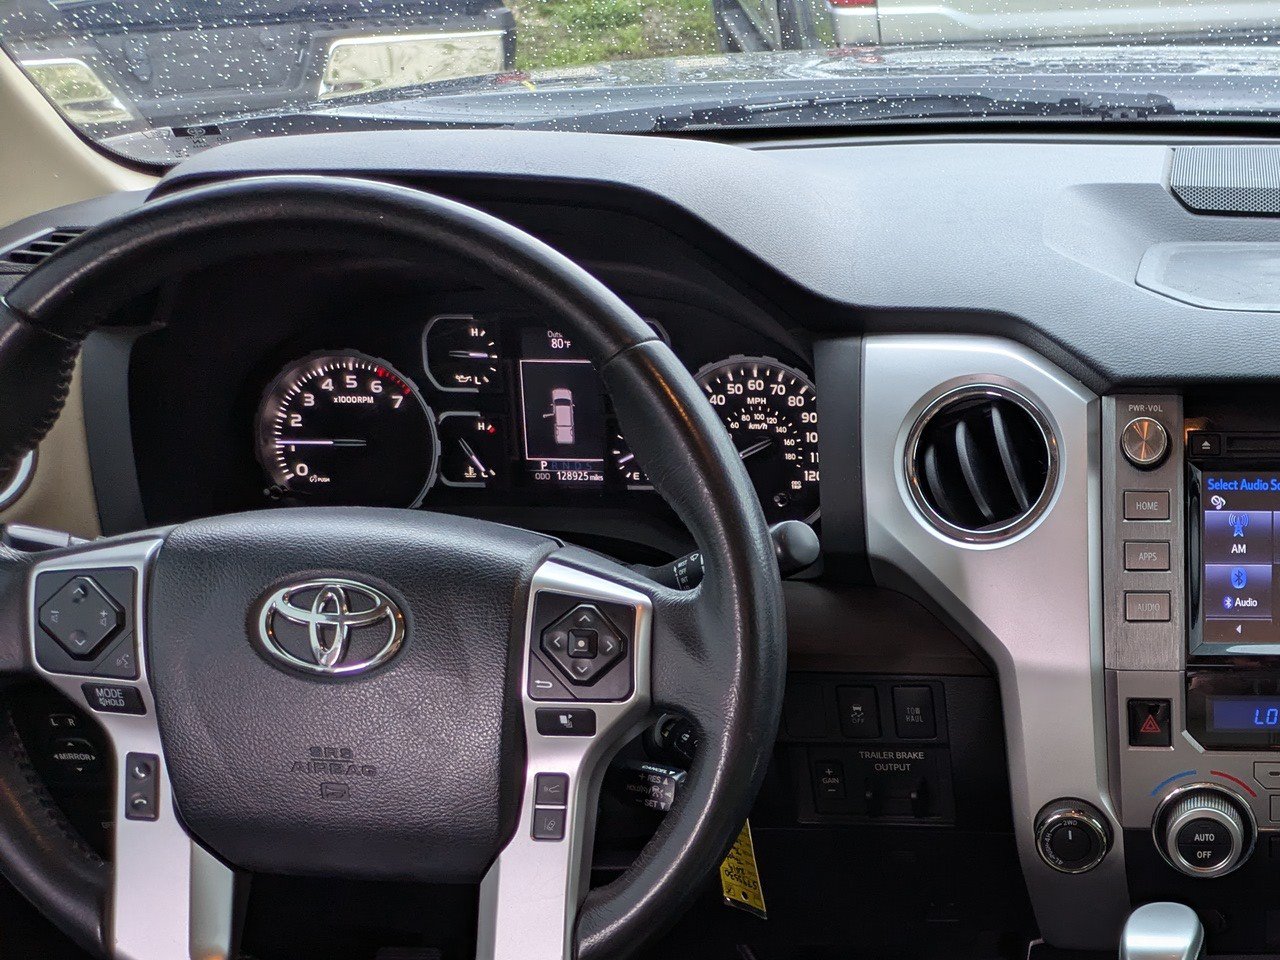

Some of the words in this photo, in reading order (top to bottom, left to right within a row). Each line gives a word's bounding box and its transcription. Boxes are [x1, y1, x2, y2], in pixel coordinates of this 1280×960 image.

[471, 328, 478, 337] H
[321, 379, 334, 391] 4
[345, 375, 358, 388] 5
[747, 380, 764, 390] 60
[370, 381, 383, 393] 6
[727, 384, 743, 394] 50
[770, 385, 786, 395] 70
[304, 394, 315, 407] 3
[392, 396, 404, 408] 7
[709, 395, 725, 405] 40
[747, 397, 767, 405] MPH
[788, 396, 804, 406] 80
[290, 414, 303, 427] 2
[801, 412, 818, 423] 90
[776, 426, 787, 434] 140
[296, 463, 309, 476] 0
[541, 460, 549, 470] P
[535, 472, 551, 480] ODO
[557, 471, 589, 481] 128925
[633, 472, 640, 481] E
[1208, 479, 1238, 490] Select
[1240, 479, 1269, 490] Audio
[1136, 502, 1158, 511] HOME
[1231, 544, 1247, 554] AM
[1138, 552, 1157, 561] APPS
[1234, 597, 1258, 607] Audio
[1137, 603, 1160, 612] AUDIO
[95, 687, 123, 698] MODE
[1254, 708, 1278, 725] LO
[51, 718, 58, 726] L
[68, 718, 76, 726] R
[859, 751, 895, 759] TRAILER
[896, 751, 925, 759] BRAKE
[1194, 833, 1215, 841] AUTO
